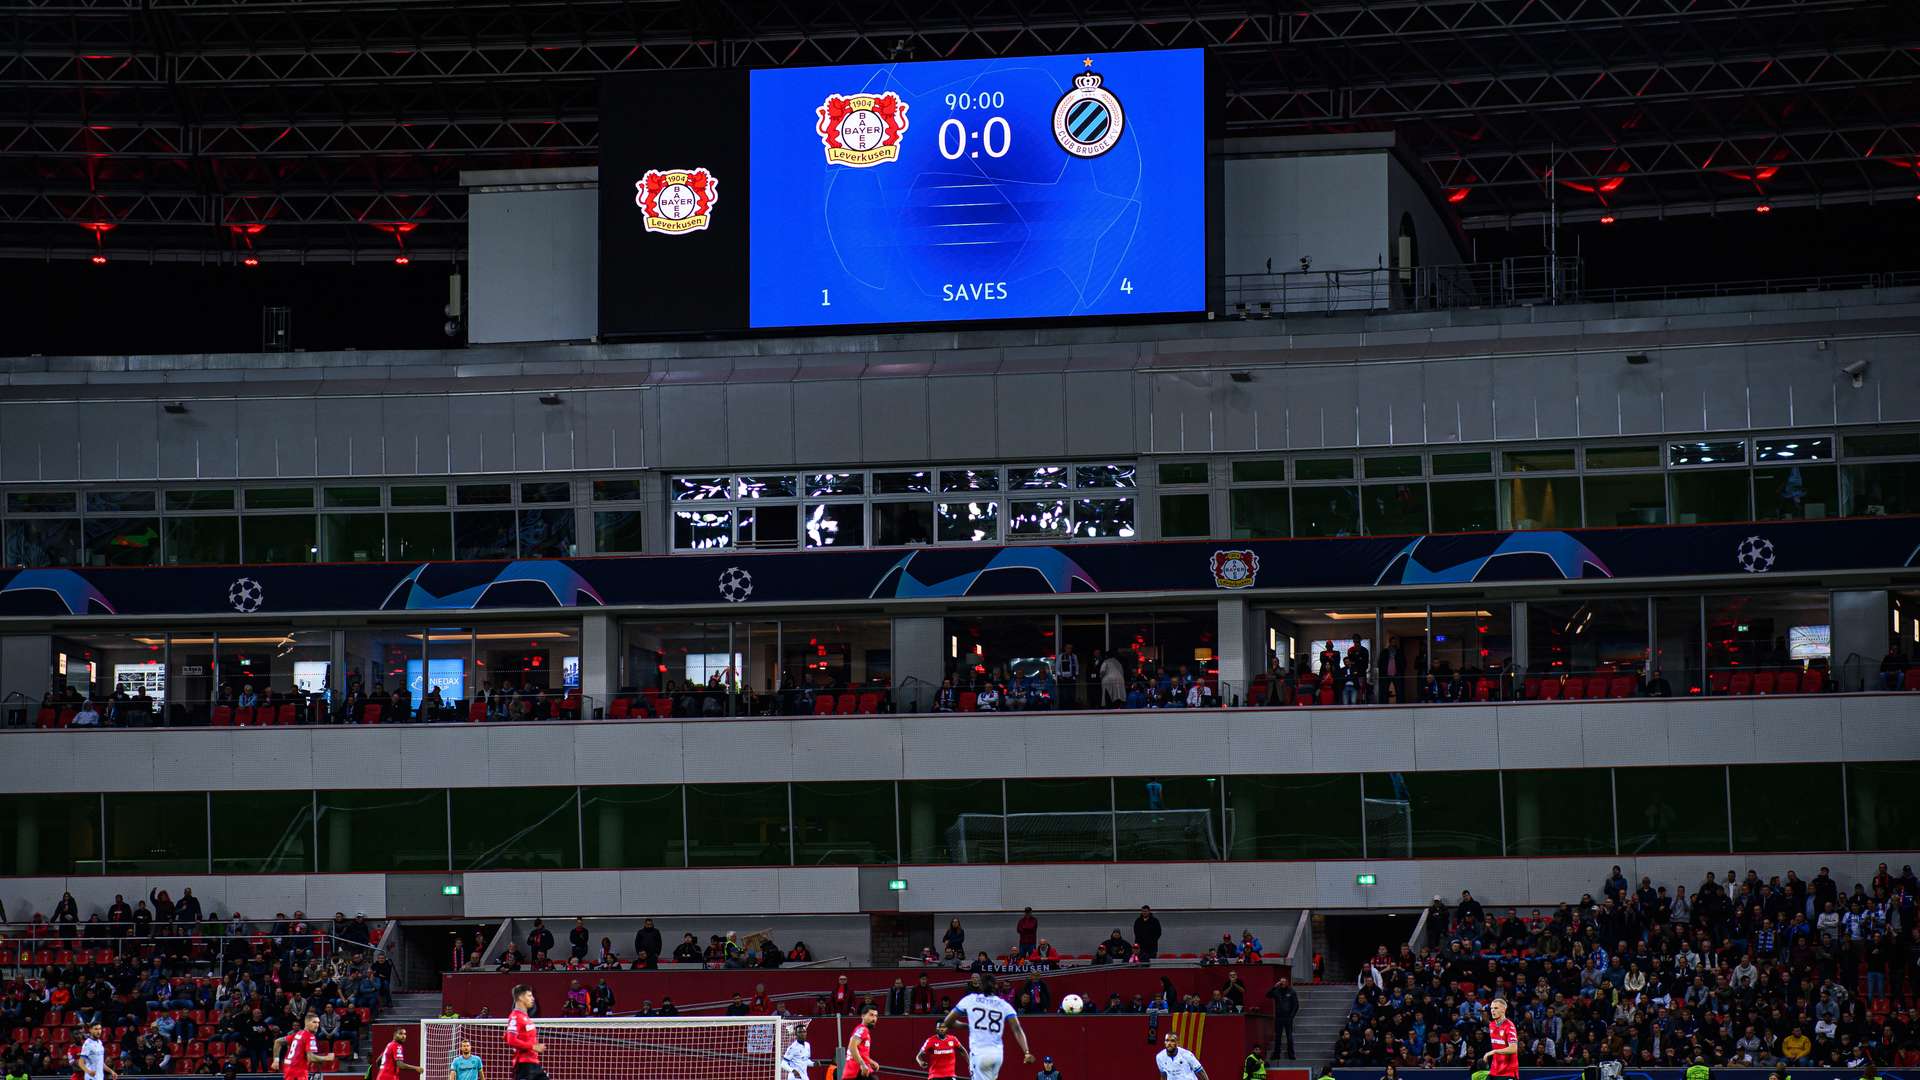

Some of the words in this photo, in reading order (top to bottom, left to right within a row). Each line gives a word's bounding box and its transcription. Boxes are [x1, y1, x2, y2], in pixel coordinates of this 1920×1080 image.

[853, 100, 872, 108] 1904
[945, 91, 1005, 110] 90:00
[845, 126, 880, 135] BAYER
[938, 116, 1011, 160] 0:0
[1058, 130, 1075, 149] CLUB
[1076, 140, 1109, 154] BRUGGE
[833, 149, 891, 161] Leverkusen
[661, 198, 693, 206] BAYER
[651, 218, 702, 230] Leverkusen
[821, 288, 831, 307] 1
[942, 282, 1008, 302] SAVES
[1120, 277, 1133, 295] 4
[981, 964, 1050, 972] LEVERKUSEN
[972, 1007, 1003, 1033] 28
[287, 1039, 298, 1059] 8
